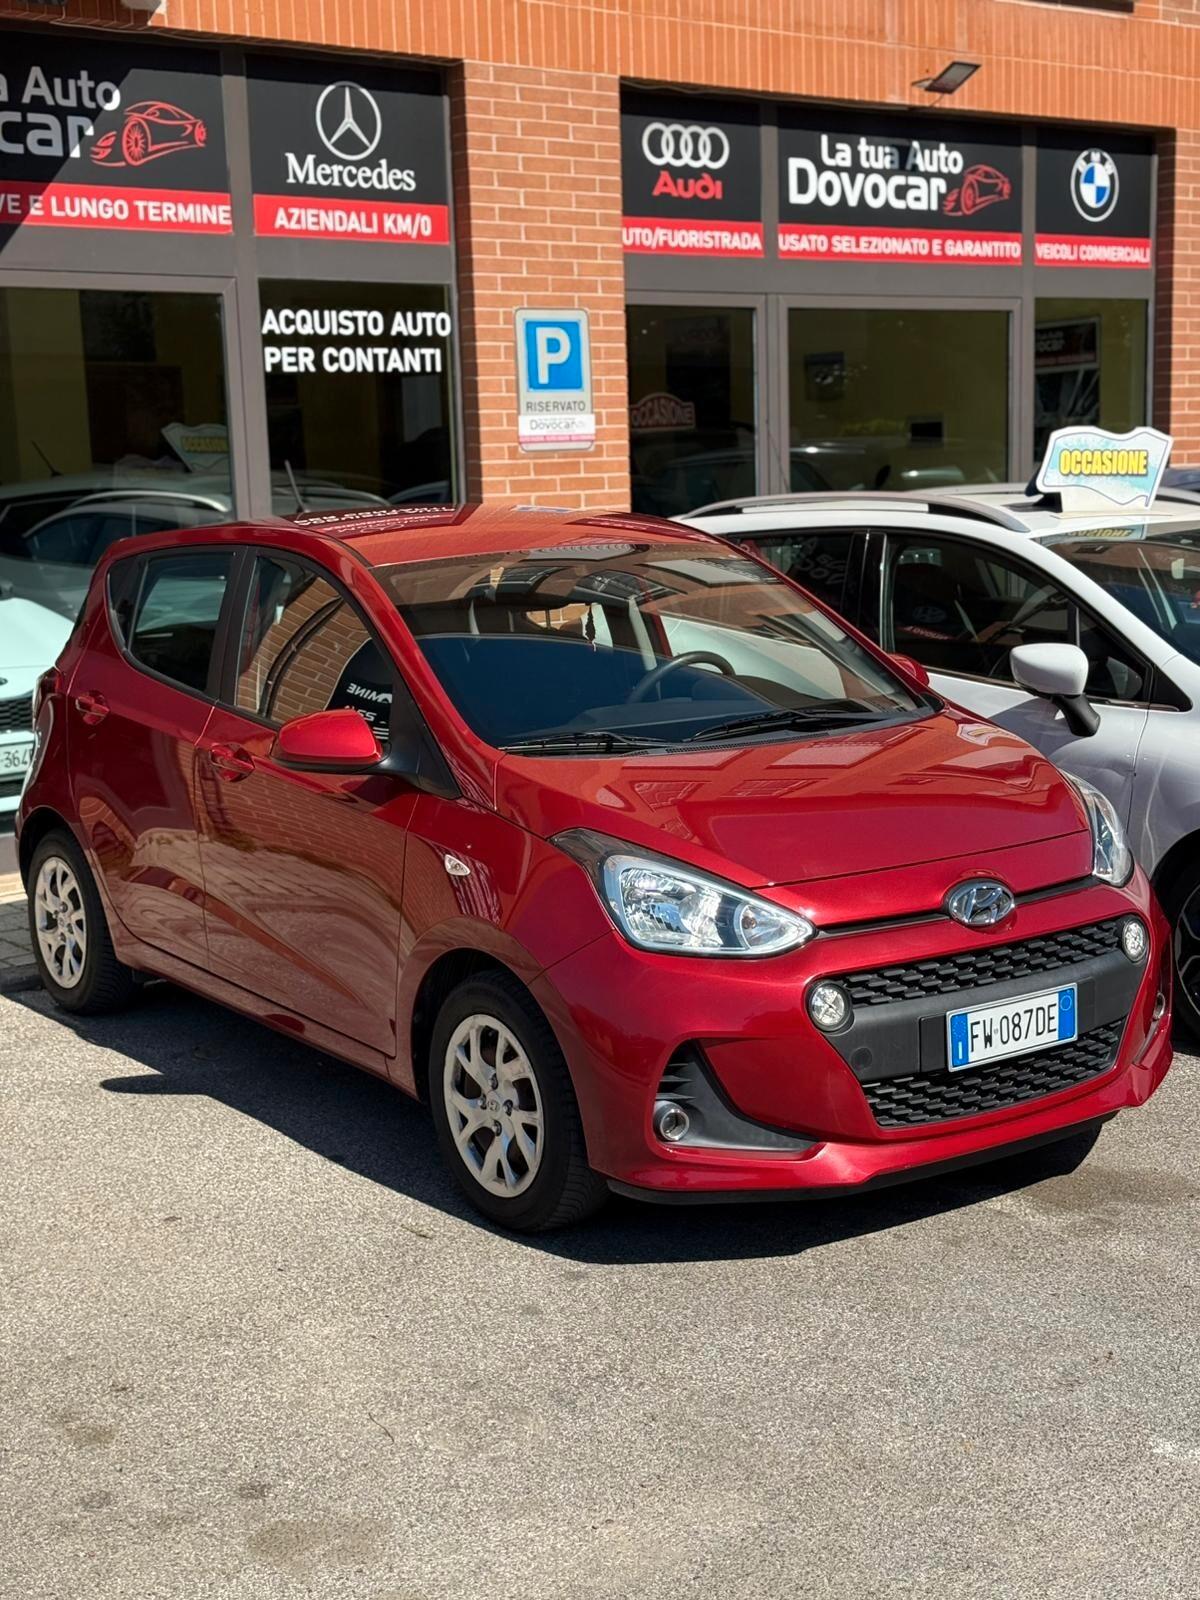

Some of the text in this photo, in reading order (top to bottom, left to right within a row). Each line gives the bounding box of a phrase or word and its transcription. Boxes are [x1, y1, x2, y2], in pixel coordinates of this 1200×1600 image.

[21, 66, 121, 111] Auto
[820, 134, 963, 174] La tua Auto
[285, 152, 416, 191] Mercedes
[652, 170, 723, 199] Audi
[788, 157, 947, 211] Dovocar
[30, 195, 45, 216] E
[51, 196, 129, 220] LUNGO
[133, 201, 232, 225] TERMINE
[274, 207, 378, 233] AZIENDALI
[778, 233, 1021, 258] USATO SELEZIONATO E GARANTITO
[1035, 243, 1150, 263] VEICOLI COMMERCIALI
[261, 308, 451, 337] ACQUISTO AUTO
[264, 346, 442, 373] PER CONTANTI
[535, 326, 571, 384] P
[526, 401, 586, 412] RISERVATO
[1059, 448, 1149, 476] OCCASIONE
